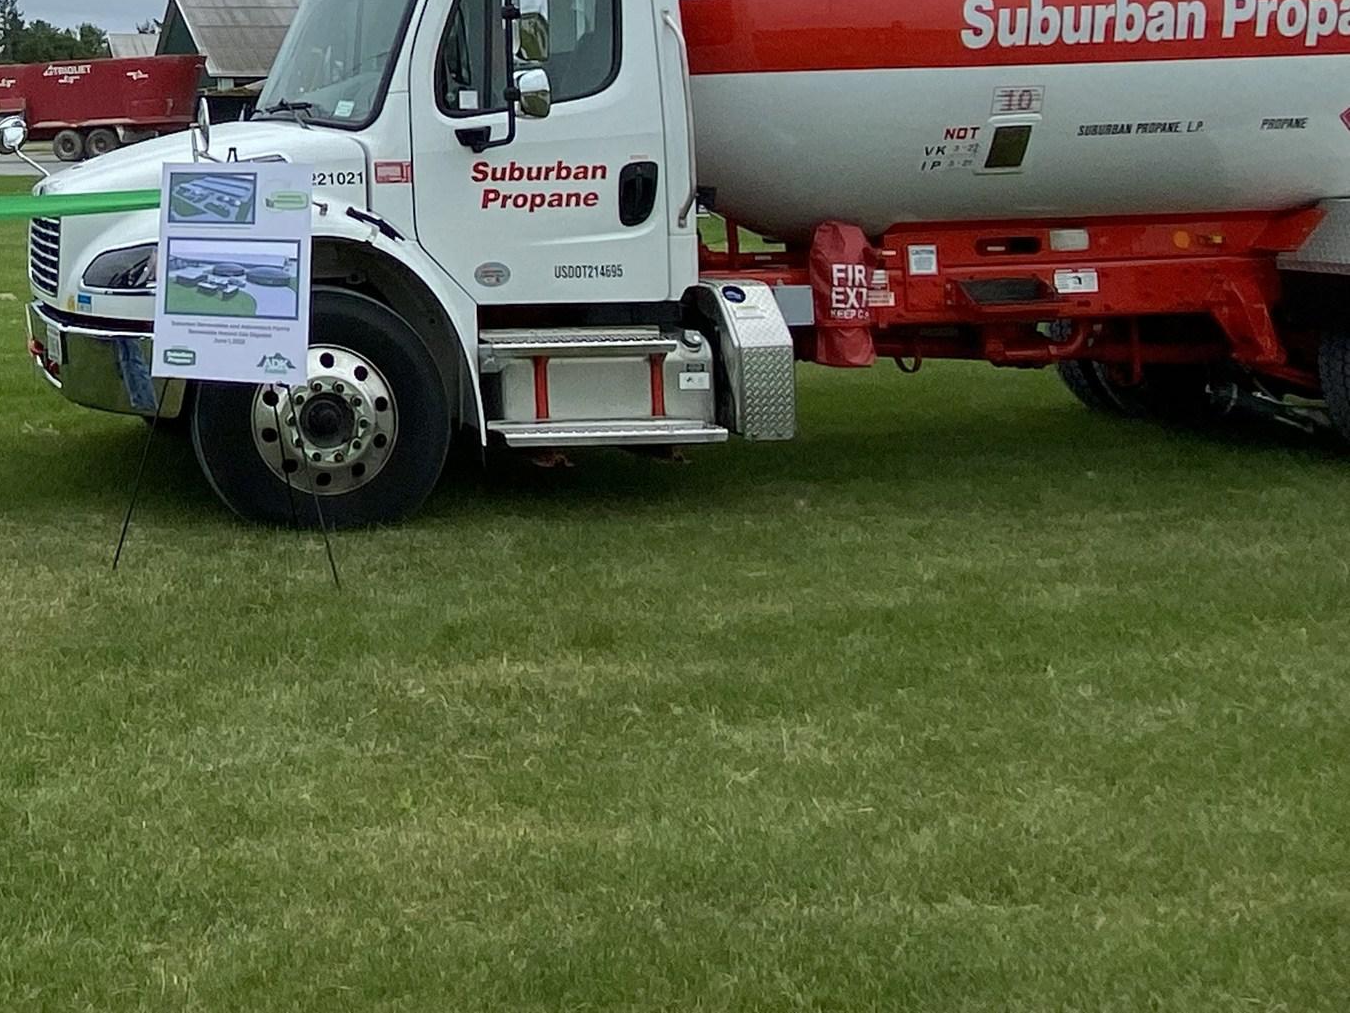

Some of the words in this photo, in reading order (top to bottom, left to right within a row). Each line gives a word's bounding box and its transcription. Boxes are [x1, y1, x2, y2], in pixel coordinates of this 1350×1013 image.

[1077, 123, 1132, 136] SUBURBAN
[1260, 116, 1309, 130] PROPANE
[470, 160, 608, 182] Suburban
[481, 188, 600, 213] Propane
